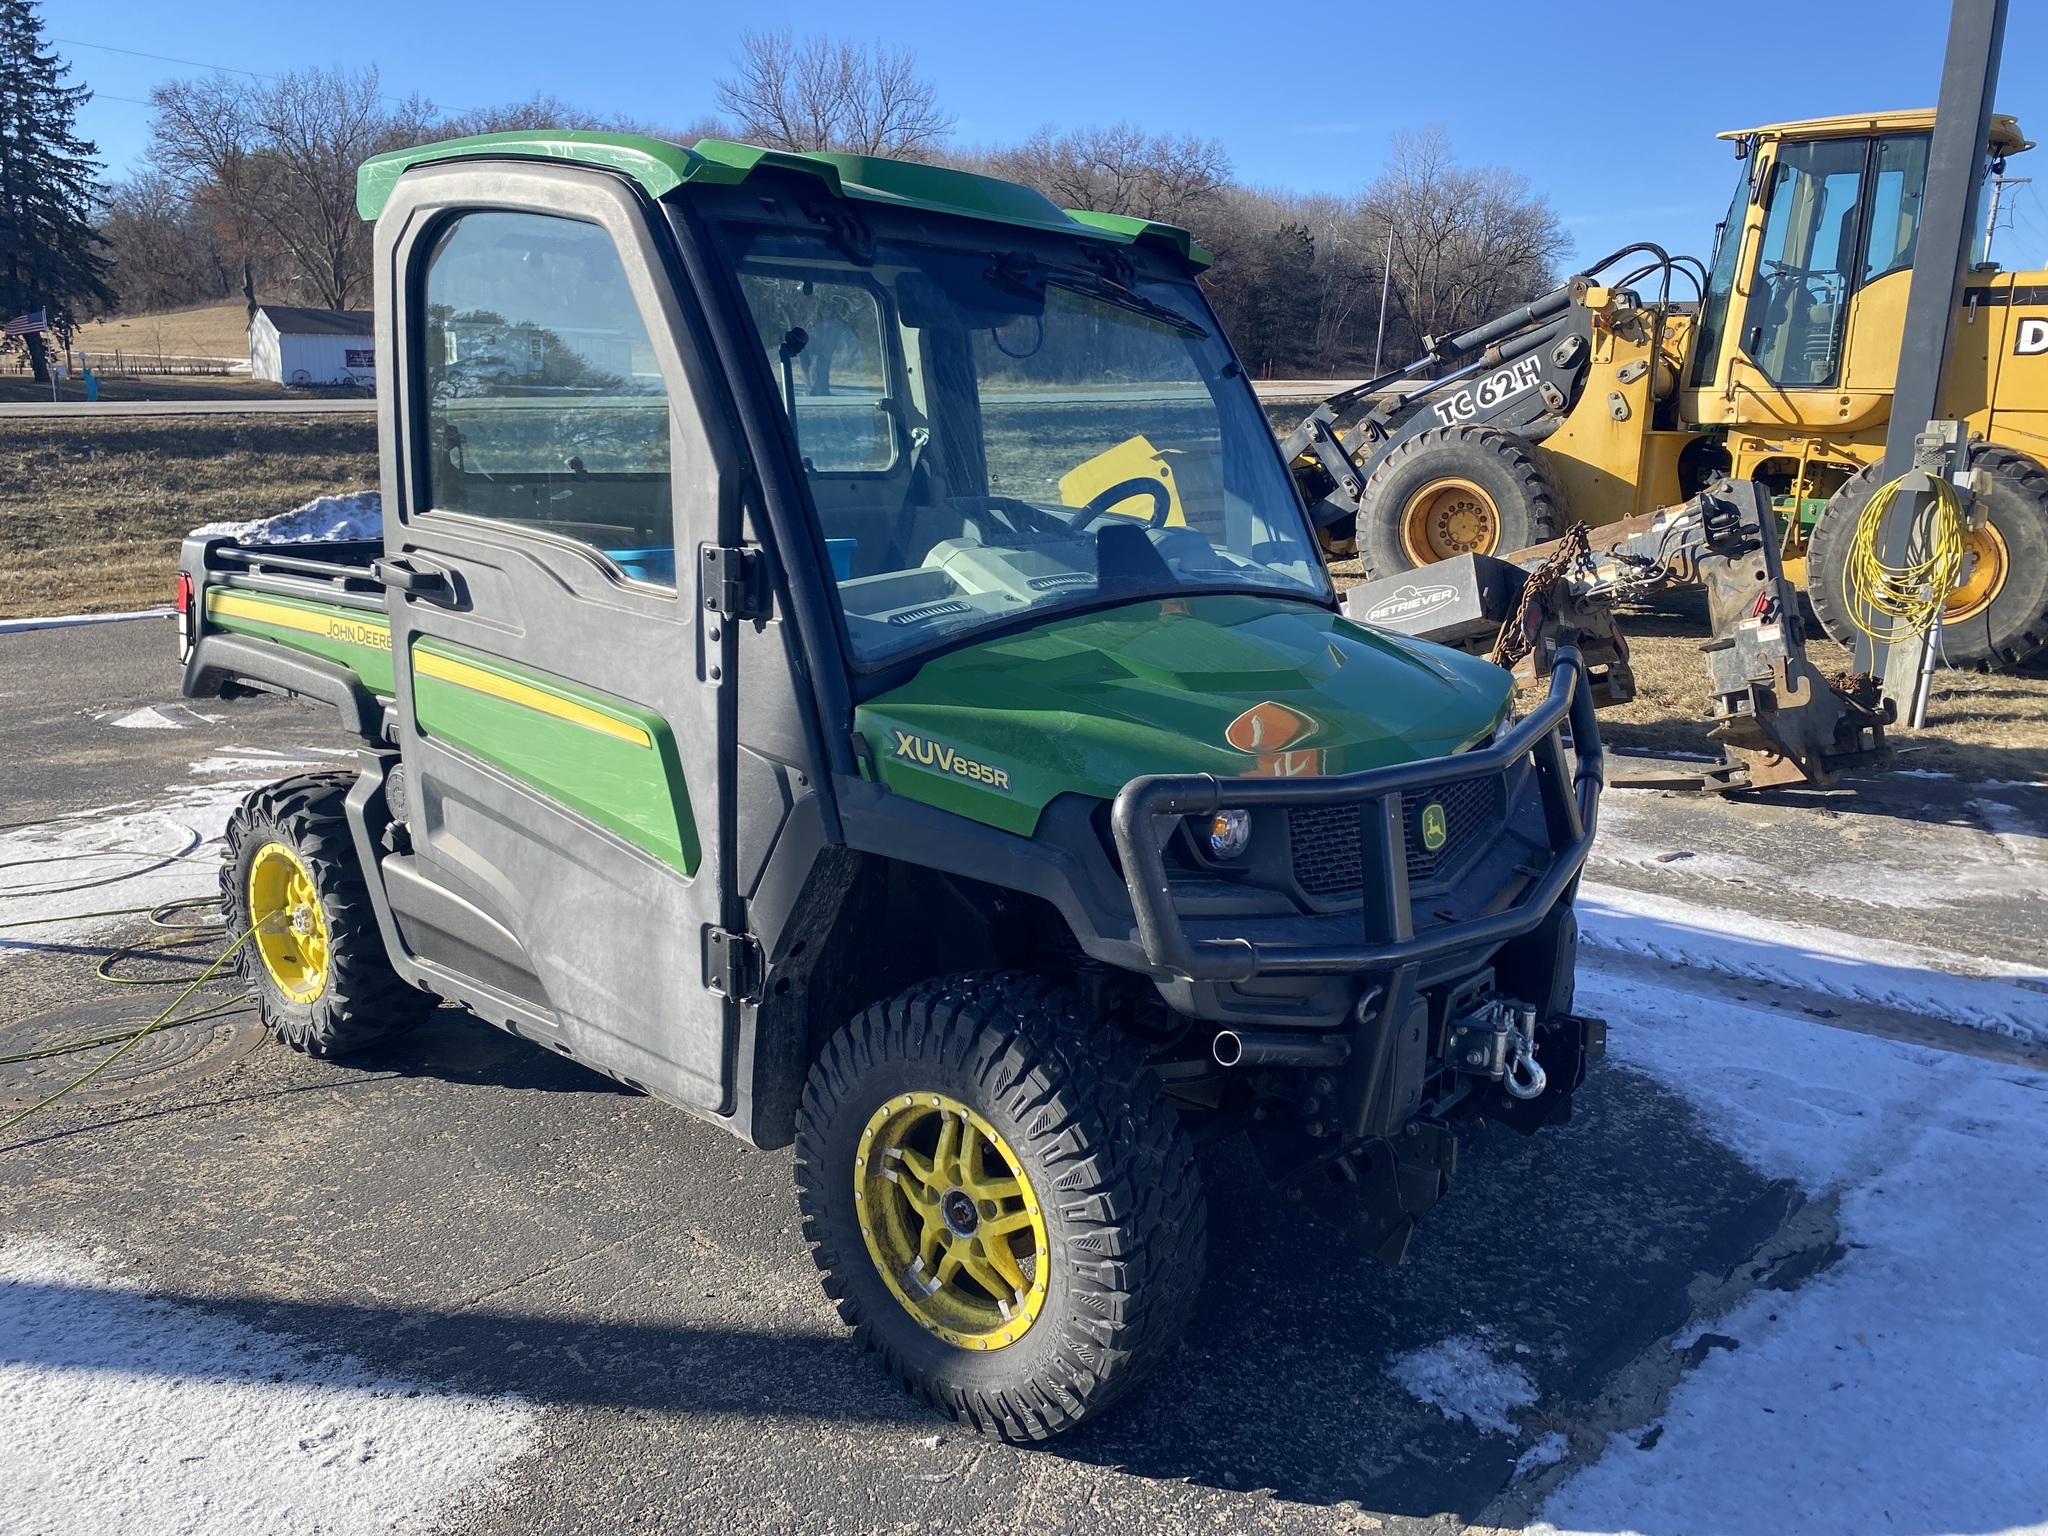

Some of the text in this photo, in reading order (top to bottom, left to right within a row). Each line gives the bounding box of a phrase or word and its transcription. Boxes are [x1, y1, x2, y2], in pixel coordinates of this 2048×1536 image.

[1433, 355, 1541, 426] TC 62H
[1369, 589, 1453, 620] RETRIEVER
[326, 620, 392, 649] JOHN DEERE
[895, 730, 1009, 790] XUV835R
